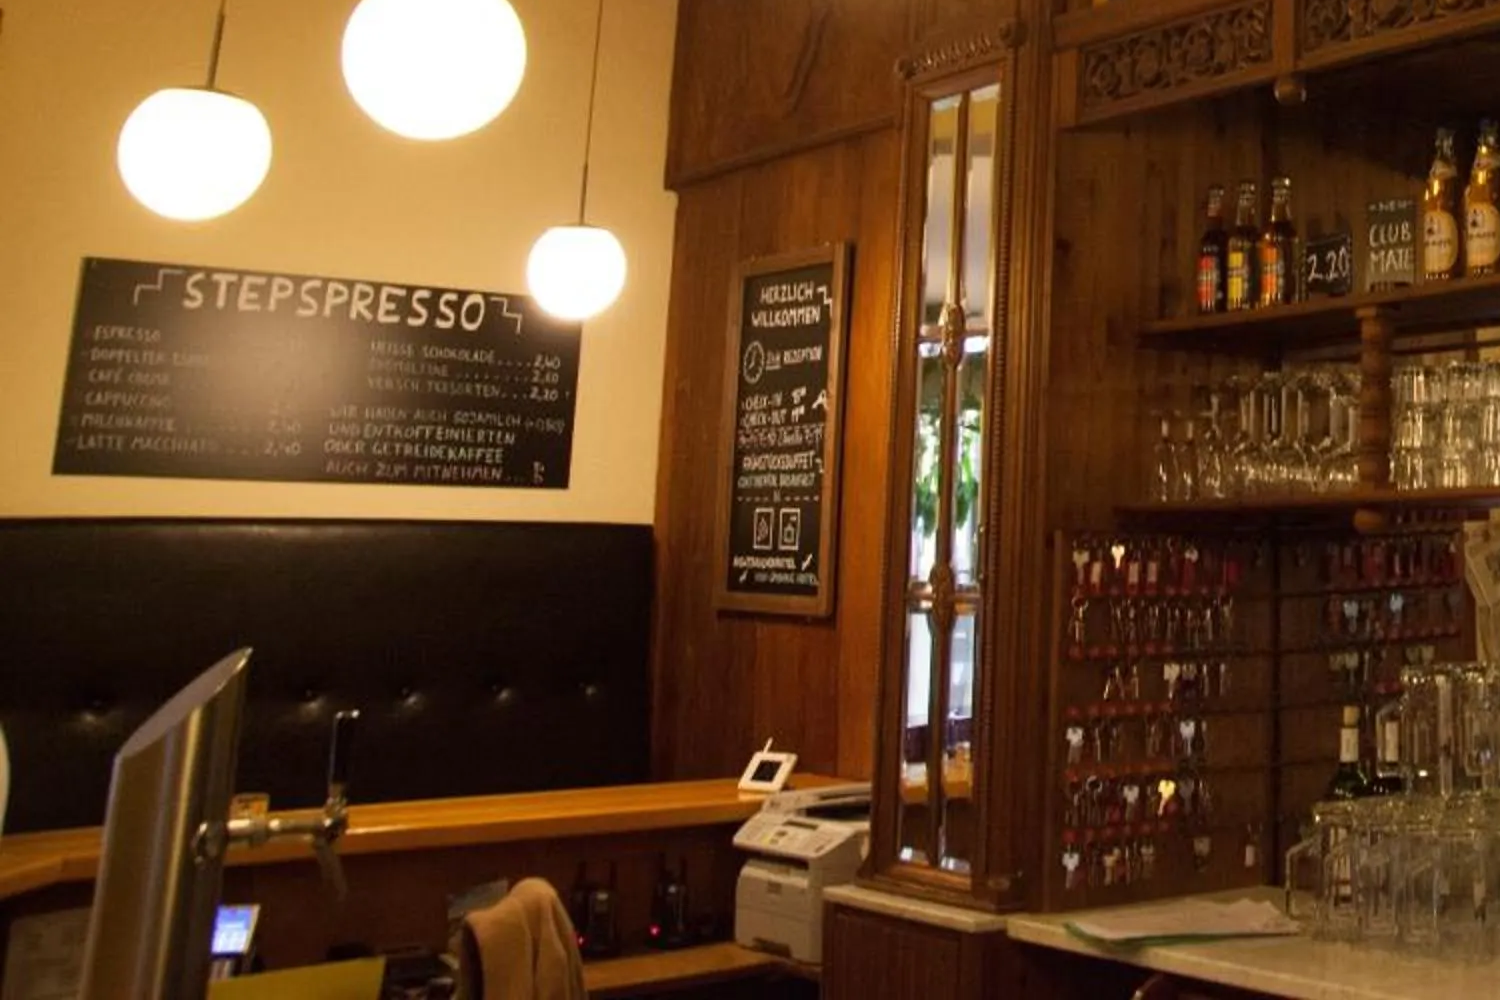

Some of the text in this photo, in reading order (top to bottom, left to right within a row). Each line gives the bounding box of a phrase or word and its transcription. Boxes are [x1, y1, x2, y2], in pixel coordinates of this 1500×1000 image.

[1369, 221, 1412, 248] CLUB
[1369, 248, 1413, 275] MATE
[182, 271, 486, 331] STEPSPRESSO
[760, 280, 814, 304] HERZLICH
[751, 305, 821, 327] WILLKOMMEN
[422, 345, 495, 365] SCHOKOLADE
[77, 436, 124, 451] LATTE
[363, 423, 516, 445] ENTKOFFEINIERTEN
[371, 440, 505, 464] GETREIDEKAFFEE
[375, 462, 408, 478] ZUM
